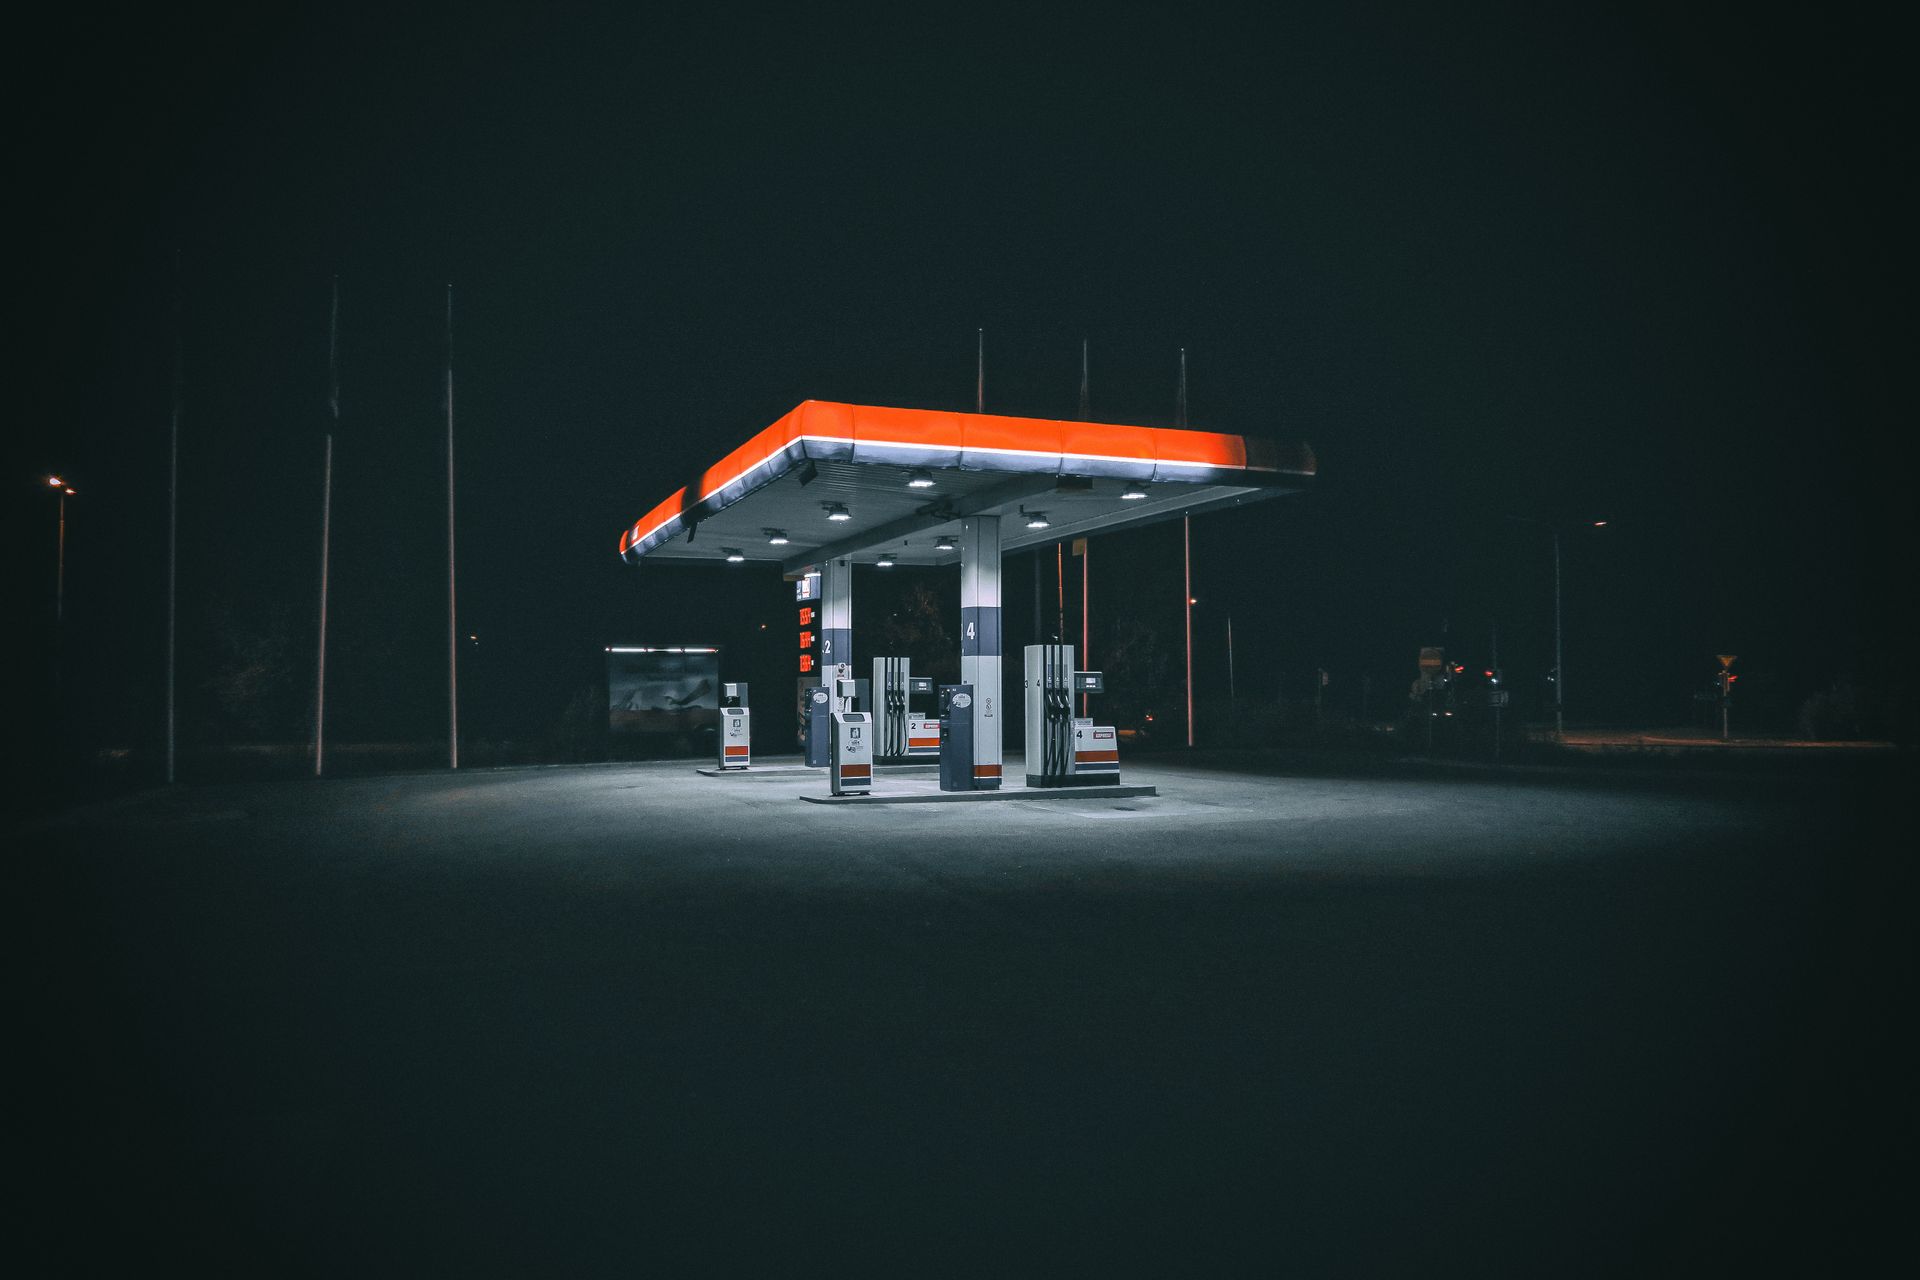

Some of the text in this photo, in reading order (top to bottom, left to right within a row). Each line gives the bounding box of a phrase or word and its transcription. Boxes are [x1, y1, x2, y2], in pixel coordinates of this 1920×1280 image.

[966, 622, 975, 640] 4
[824, 640, 831, 654] 2
[911, 722, 916, 730] 2
[1076, 730, 1083, 739] 4
